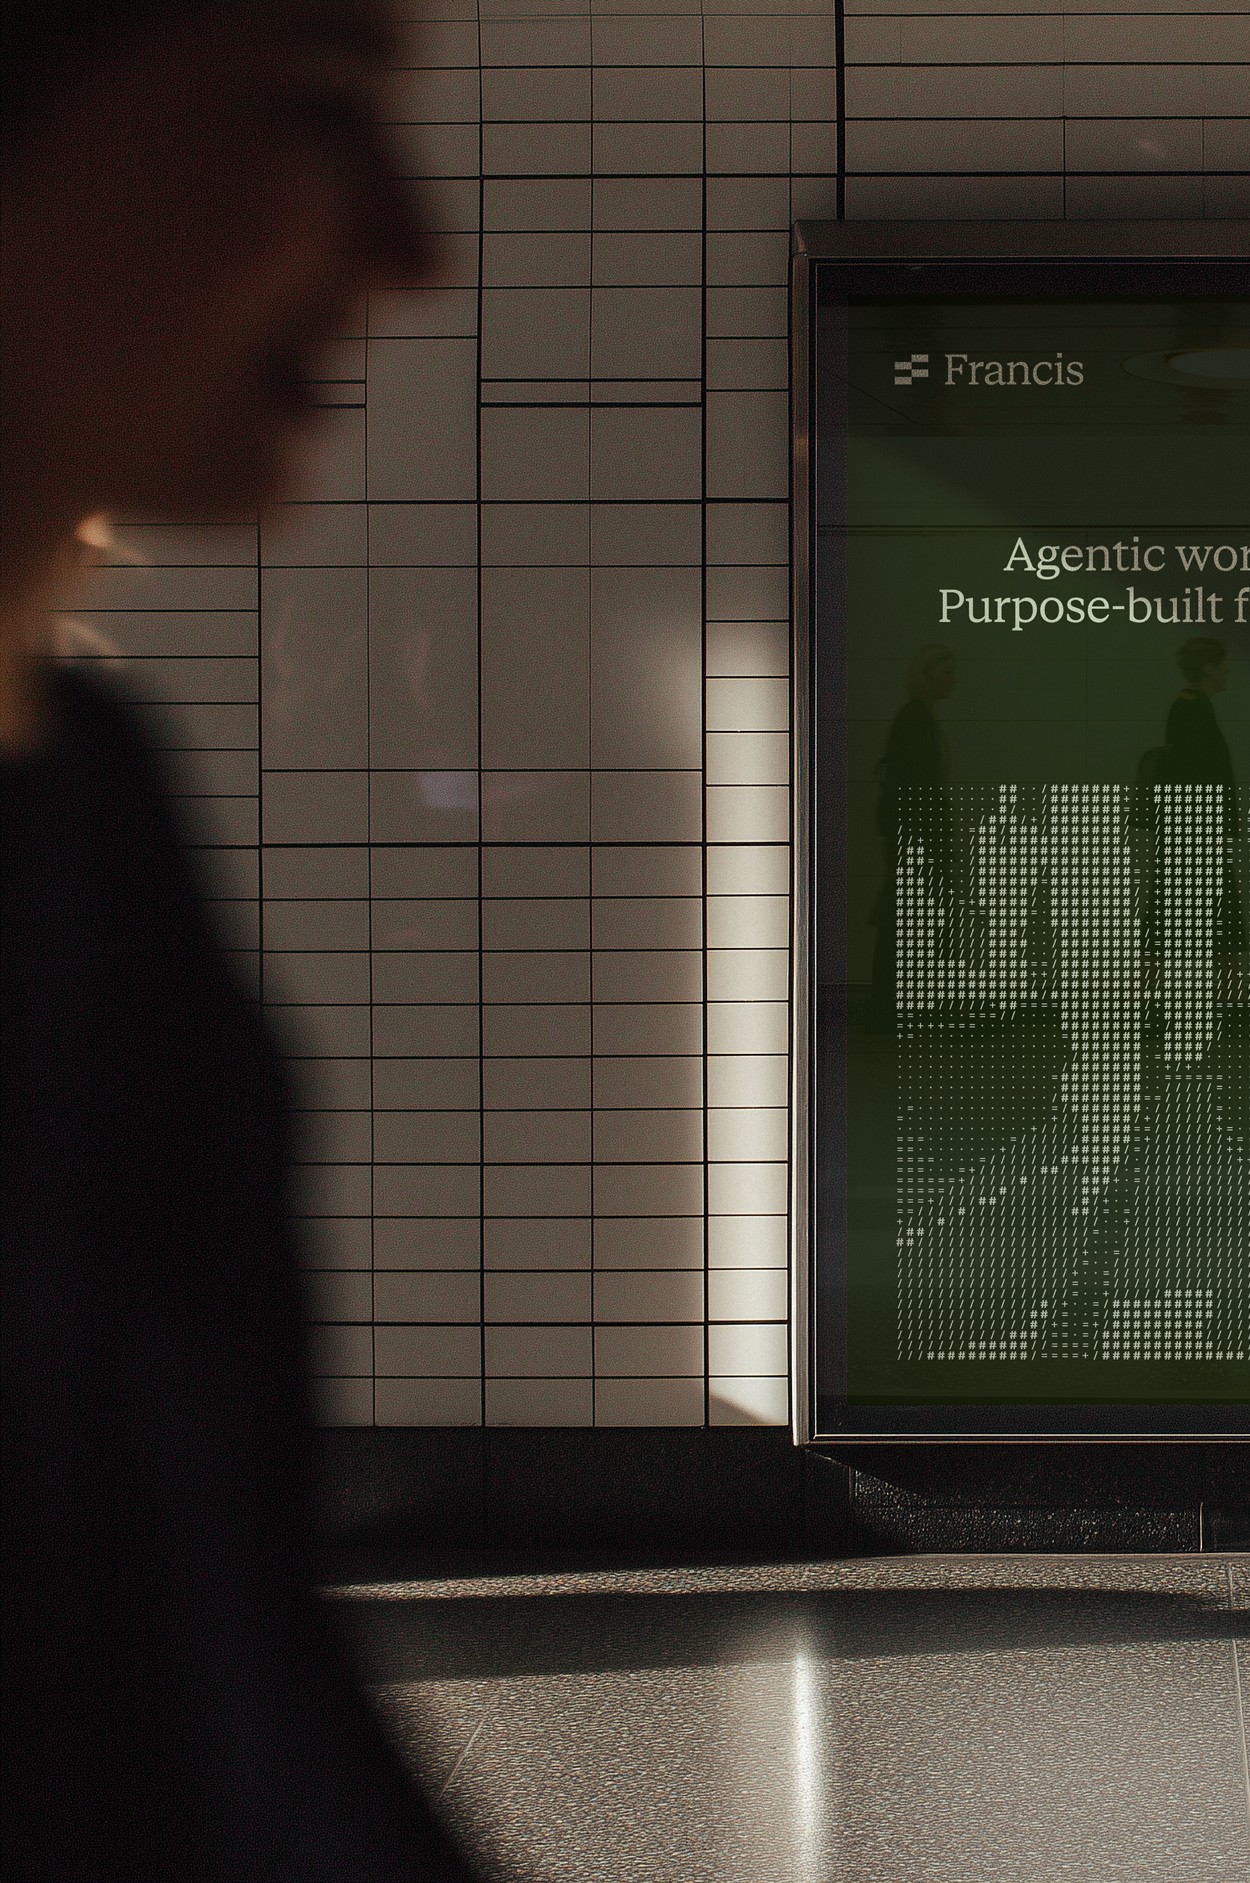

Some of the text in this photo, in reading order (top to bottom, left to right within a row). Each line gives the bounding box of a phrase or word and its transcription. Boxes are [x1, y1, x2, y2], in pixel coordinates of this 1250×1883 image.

[944, 352, 1084, 386] Francis
[1003, 536, 1166, 581] Agentic
[938, 587, 1224, 632] Purpose-built
